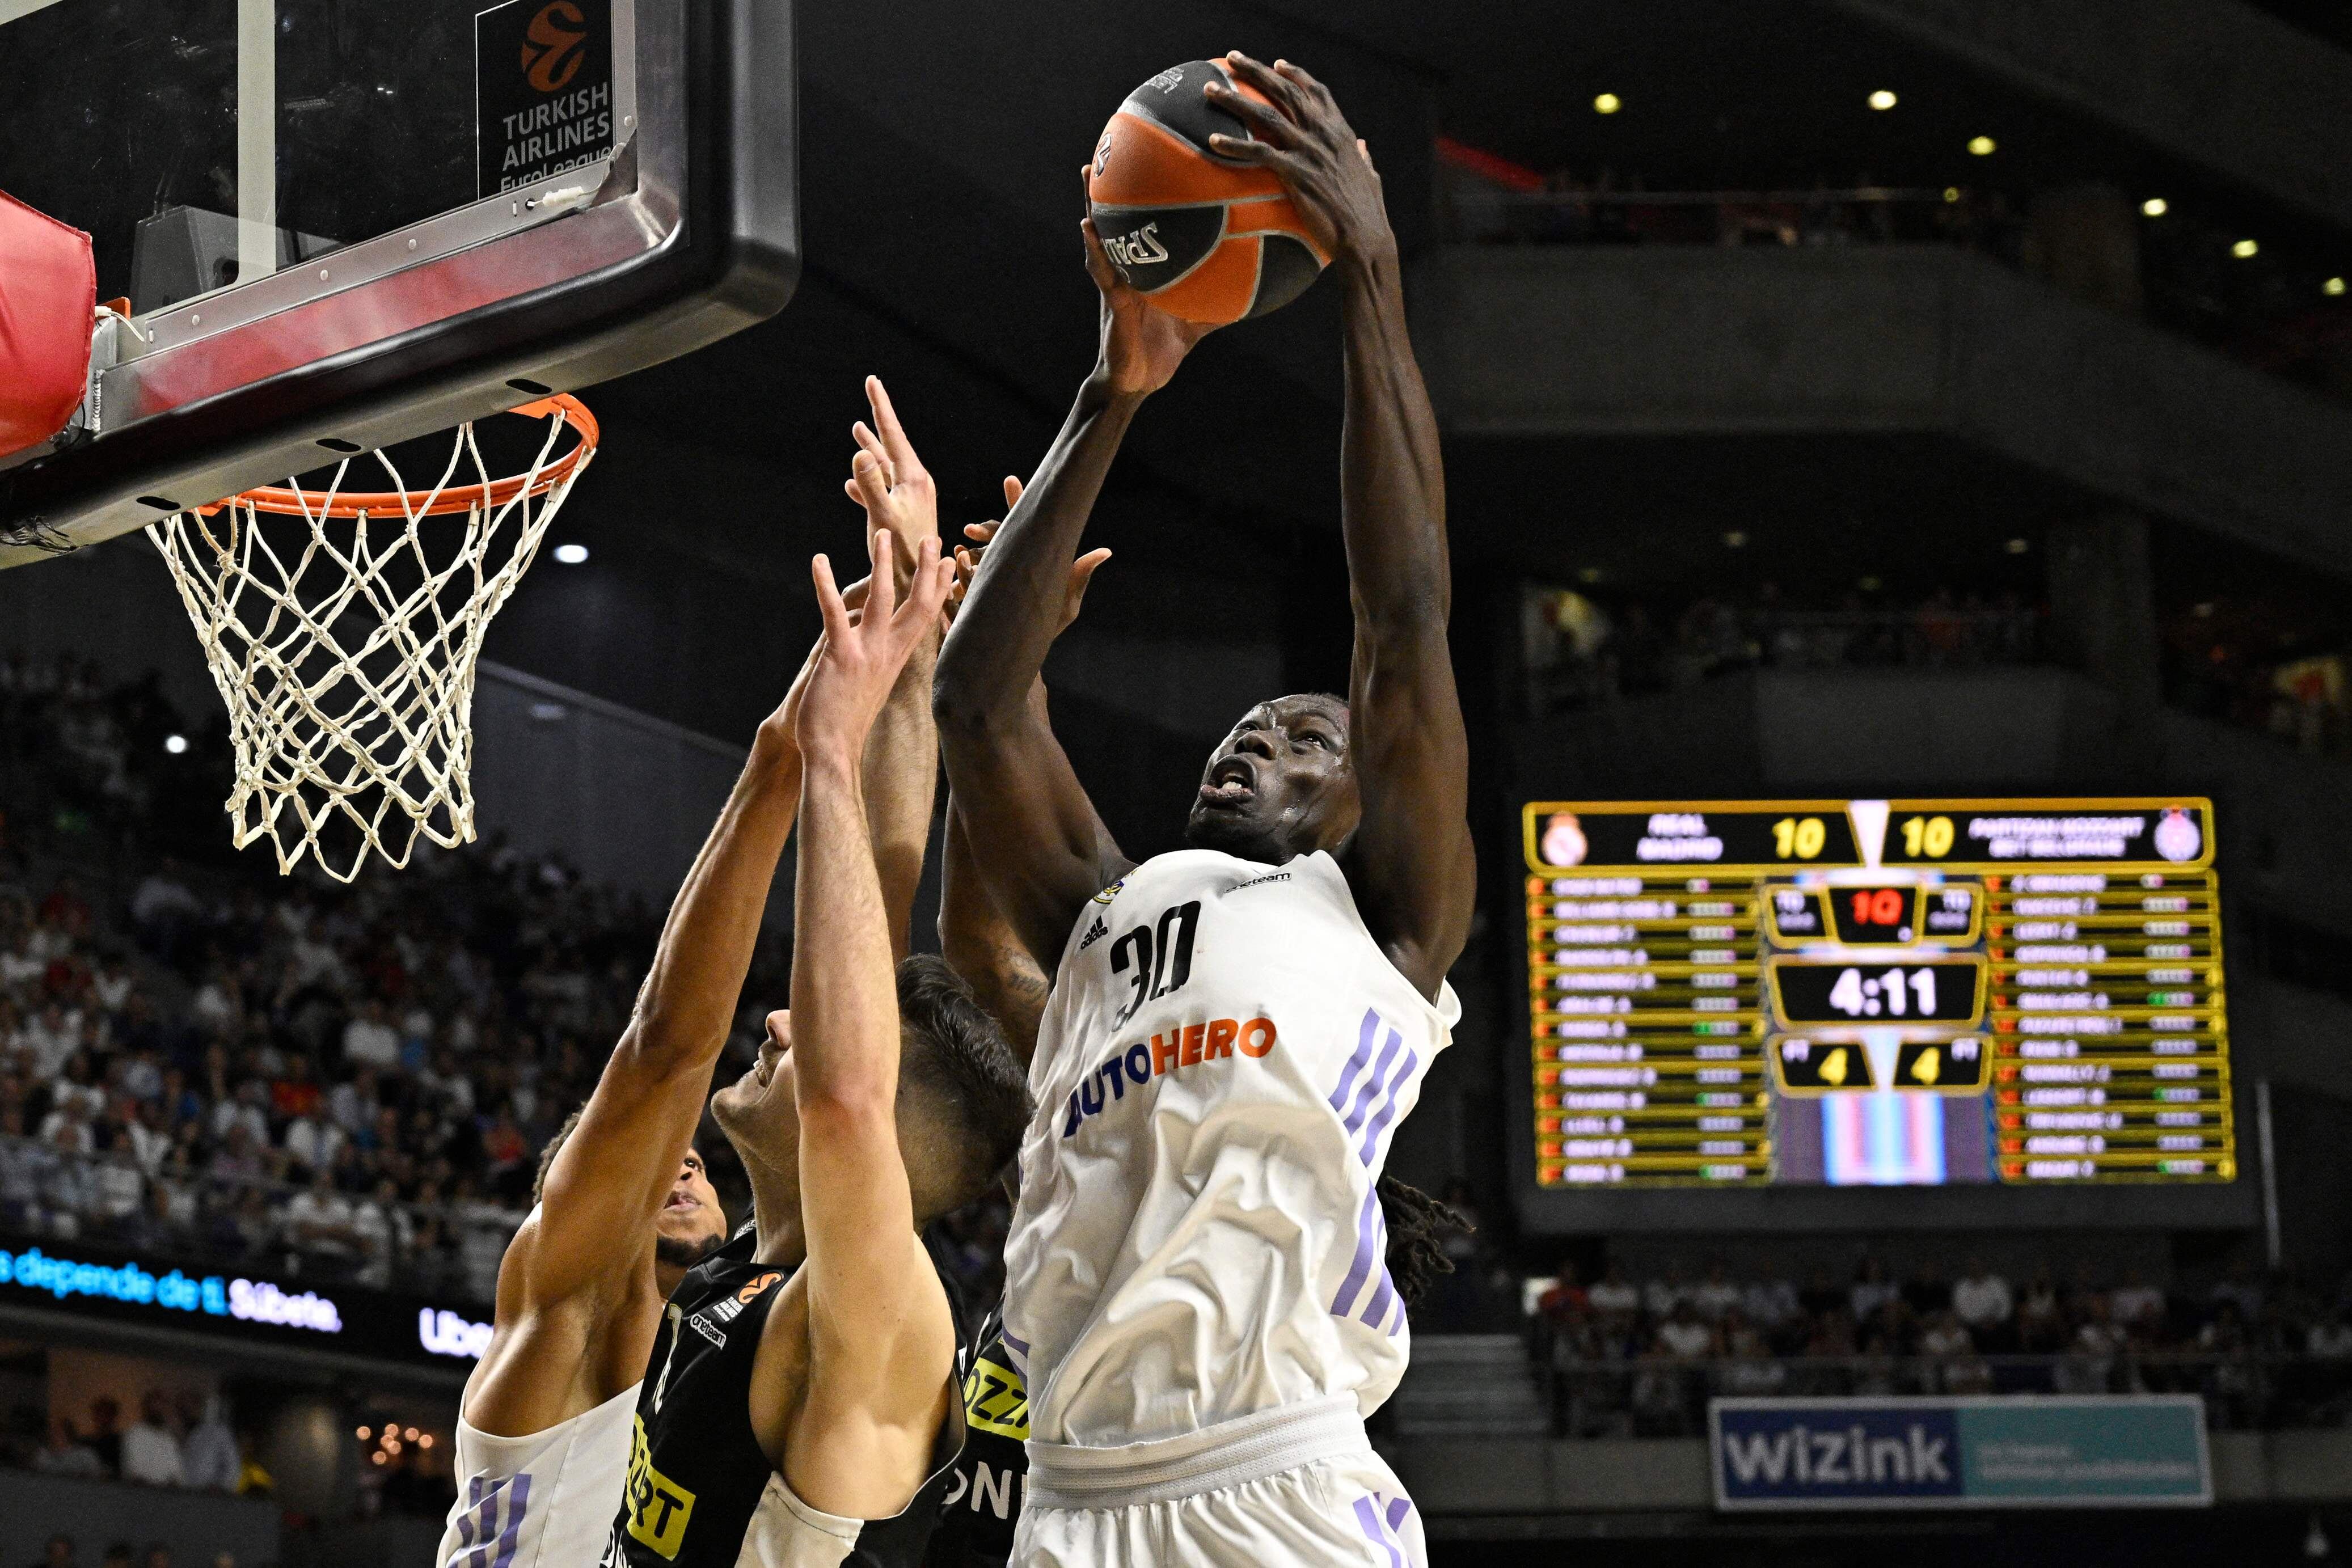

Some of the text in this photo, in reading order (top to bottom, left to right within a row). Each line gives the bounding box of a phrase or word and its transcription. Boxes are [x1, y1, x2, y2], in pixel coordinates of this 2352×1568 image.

[503, 82, 607, 140] TURKISH
[502, 111, 610, 172] AIRLINES
[1101, 222, 1168, 265] SPAL
[1772, 817, 1826, 859] 10
[1901, 815, 1955, 858] 10
[1850, 888, 1903, 925] 10
[1080, 926, 1108, 950] adidas
[1110, 901, 1201, 1032] 30
[1829, 967, 1936, 1016] 4:11
[1063, 1017, 1277, 1138] AUTOHERO
[1818, 1047, 1848, 1086] 4
[1910, 1046, 1941, 1085] 4
